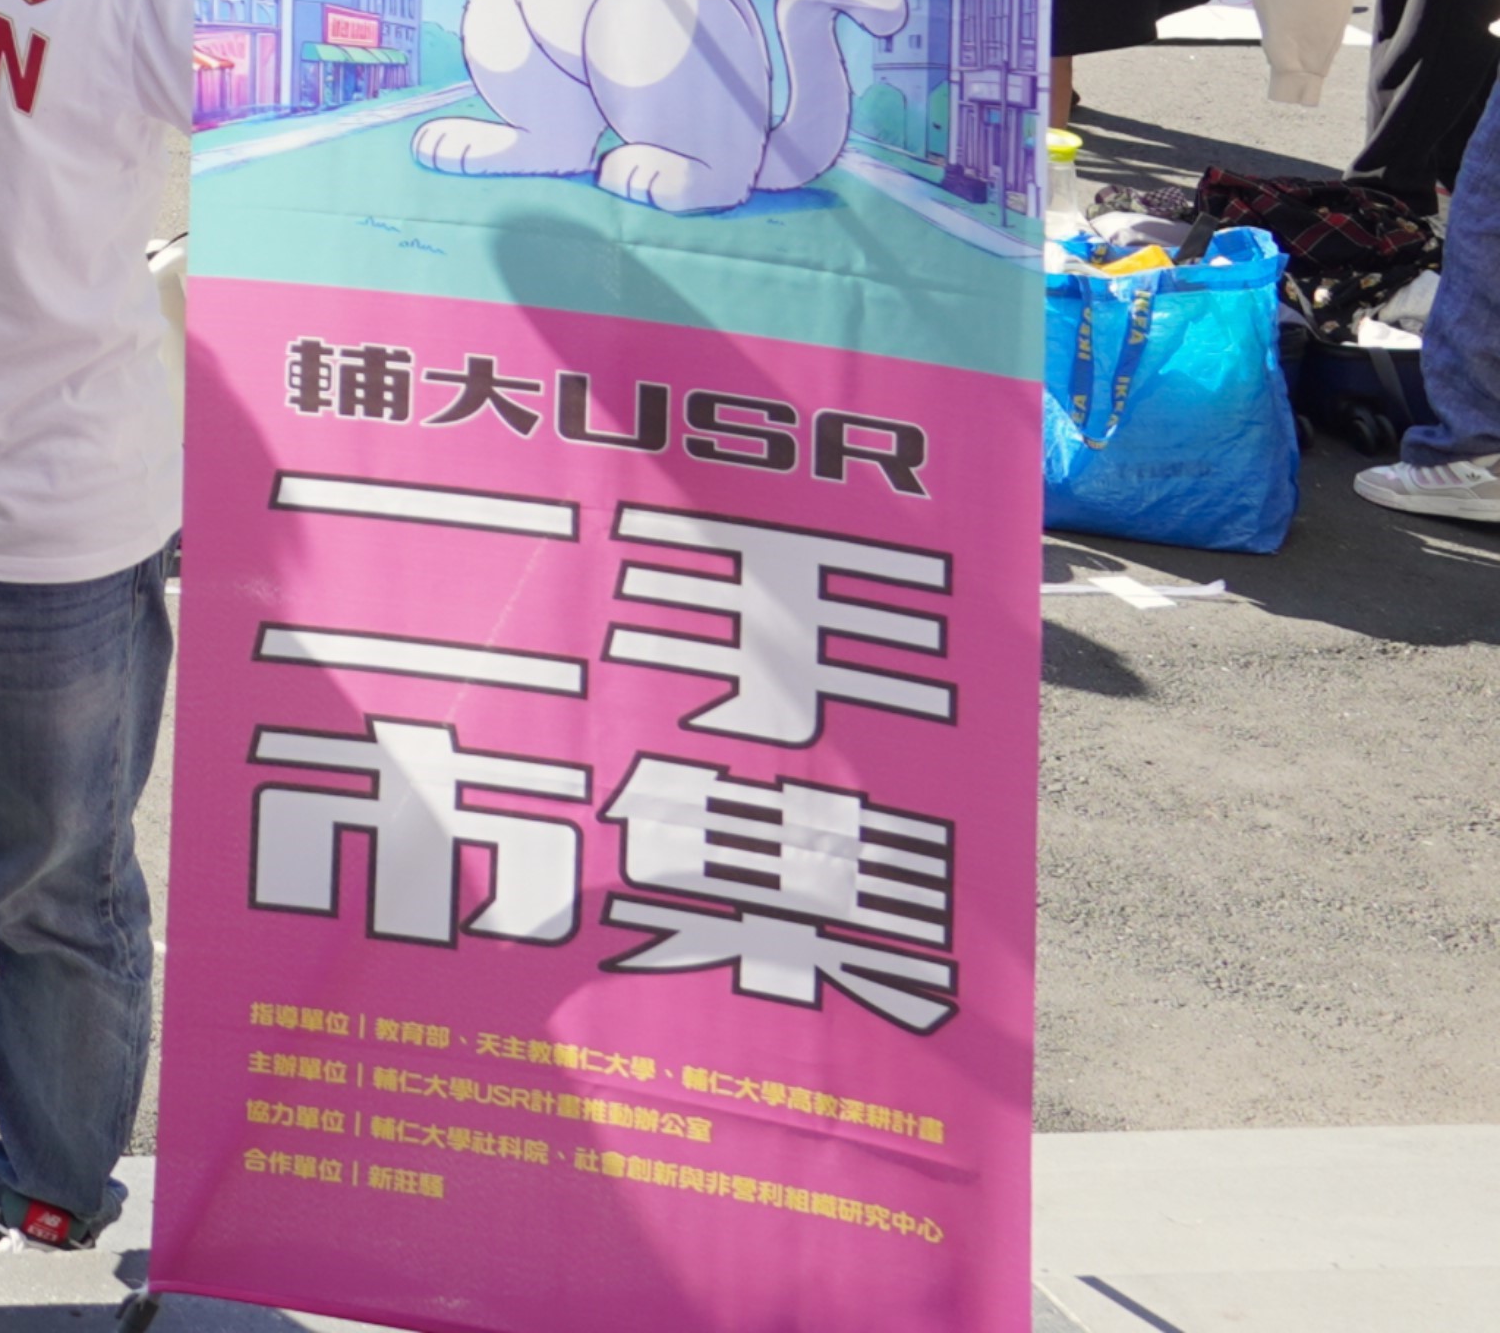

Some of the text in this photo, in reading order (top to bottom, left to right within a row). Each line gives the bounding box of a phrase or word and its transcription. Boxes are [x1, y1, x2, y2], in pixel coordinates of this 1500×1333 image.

[1077, 306, 1093, 361] IKEA
[1129, 289, 1153, 346] IKEA
[284, 334, 935, 501] 輔大USR
[248, 469, 961, 751] 二手
[245, 712, 961, 1037] 市集
